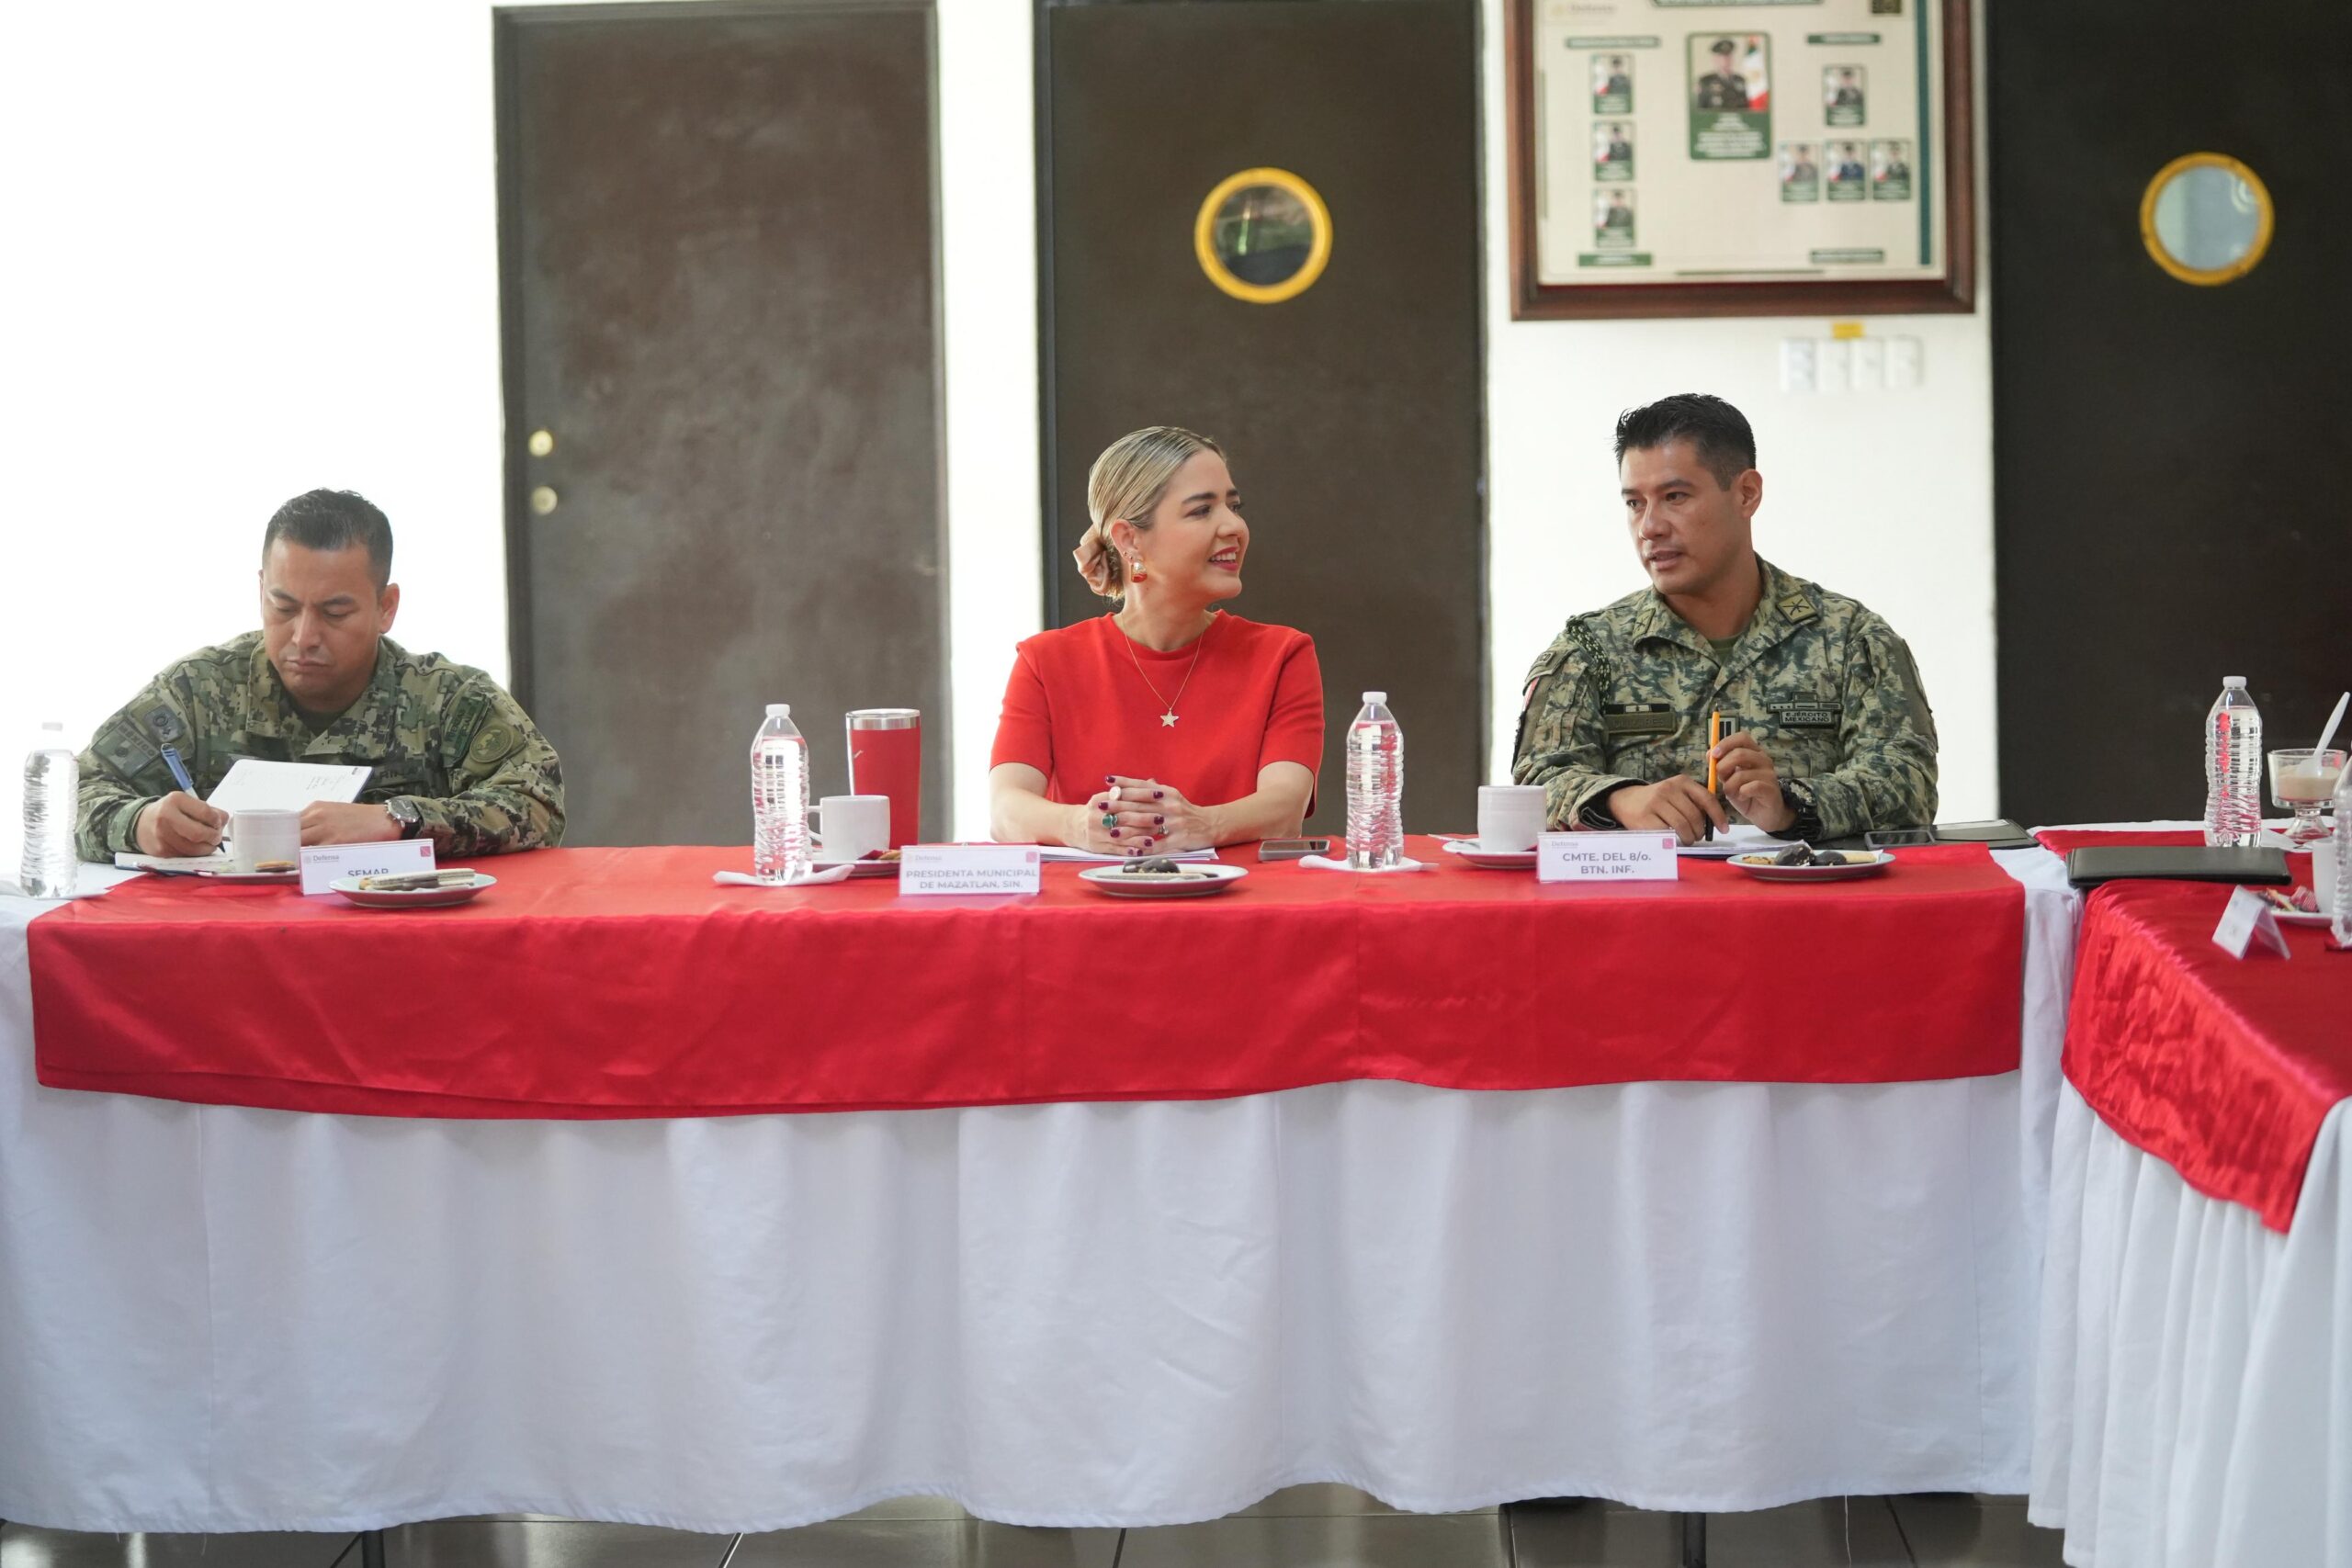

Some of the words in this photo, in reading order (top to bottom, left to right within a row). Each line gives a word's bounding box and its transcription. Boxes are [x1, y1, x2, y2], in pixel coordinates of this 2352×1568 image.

[1562, 852, 1600, 862] CMTE.
[1602, 852, 1627, 862] DEL
[906, 870, 974, 878] PRESIDENTA
[977, 869, 1037, 877] MUNICIPAL
[1580, 865, 1609, 874] BTN.
[1611, 864, 1635, 874] INF.
[920, 881, 934, 889] DE
